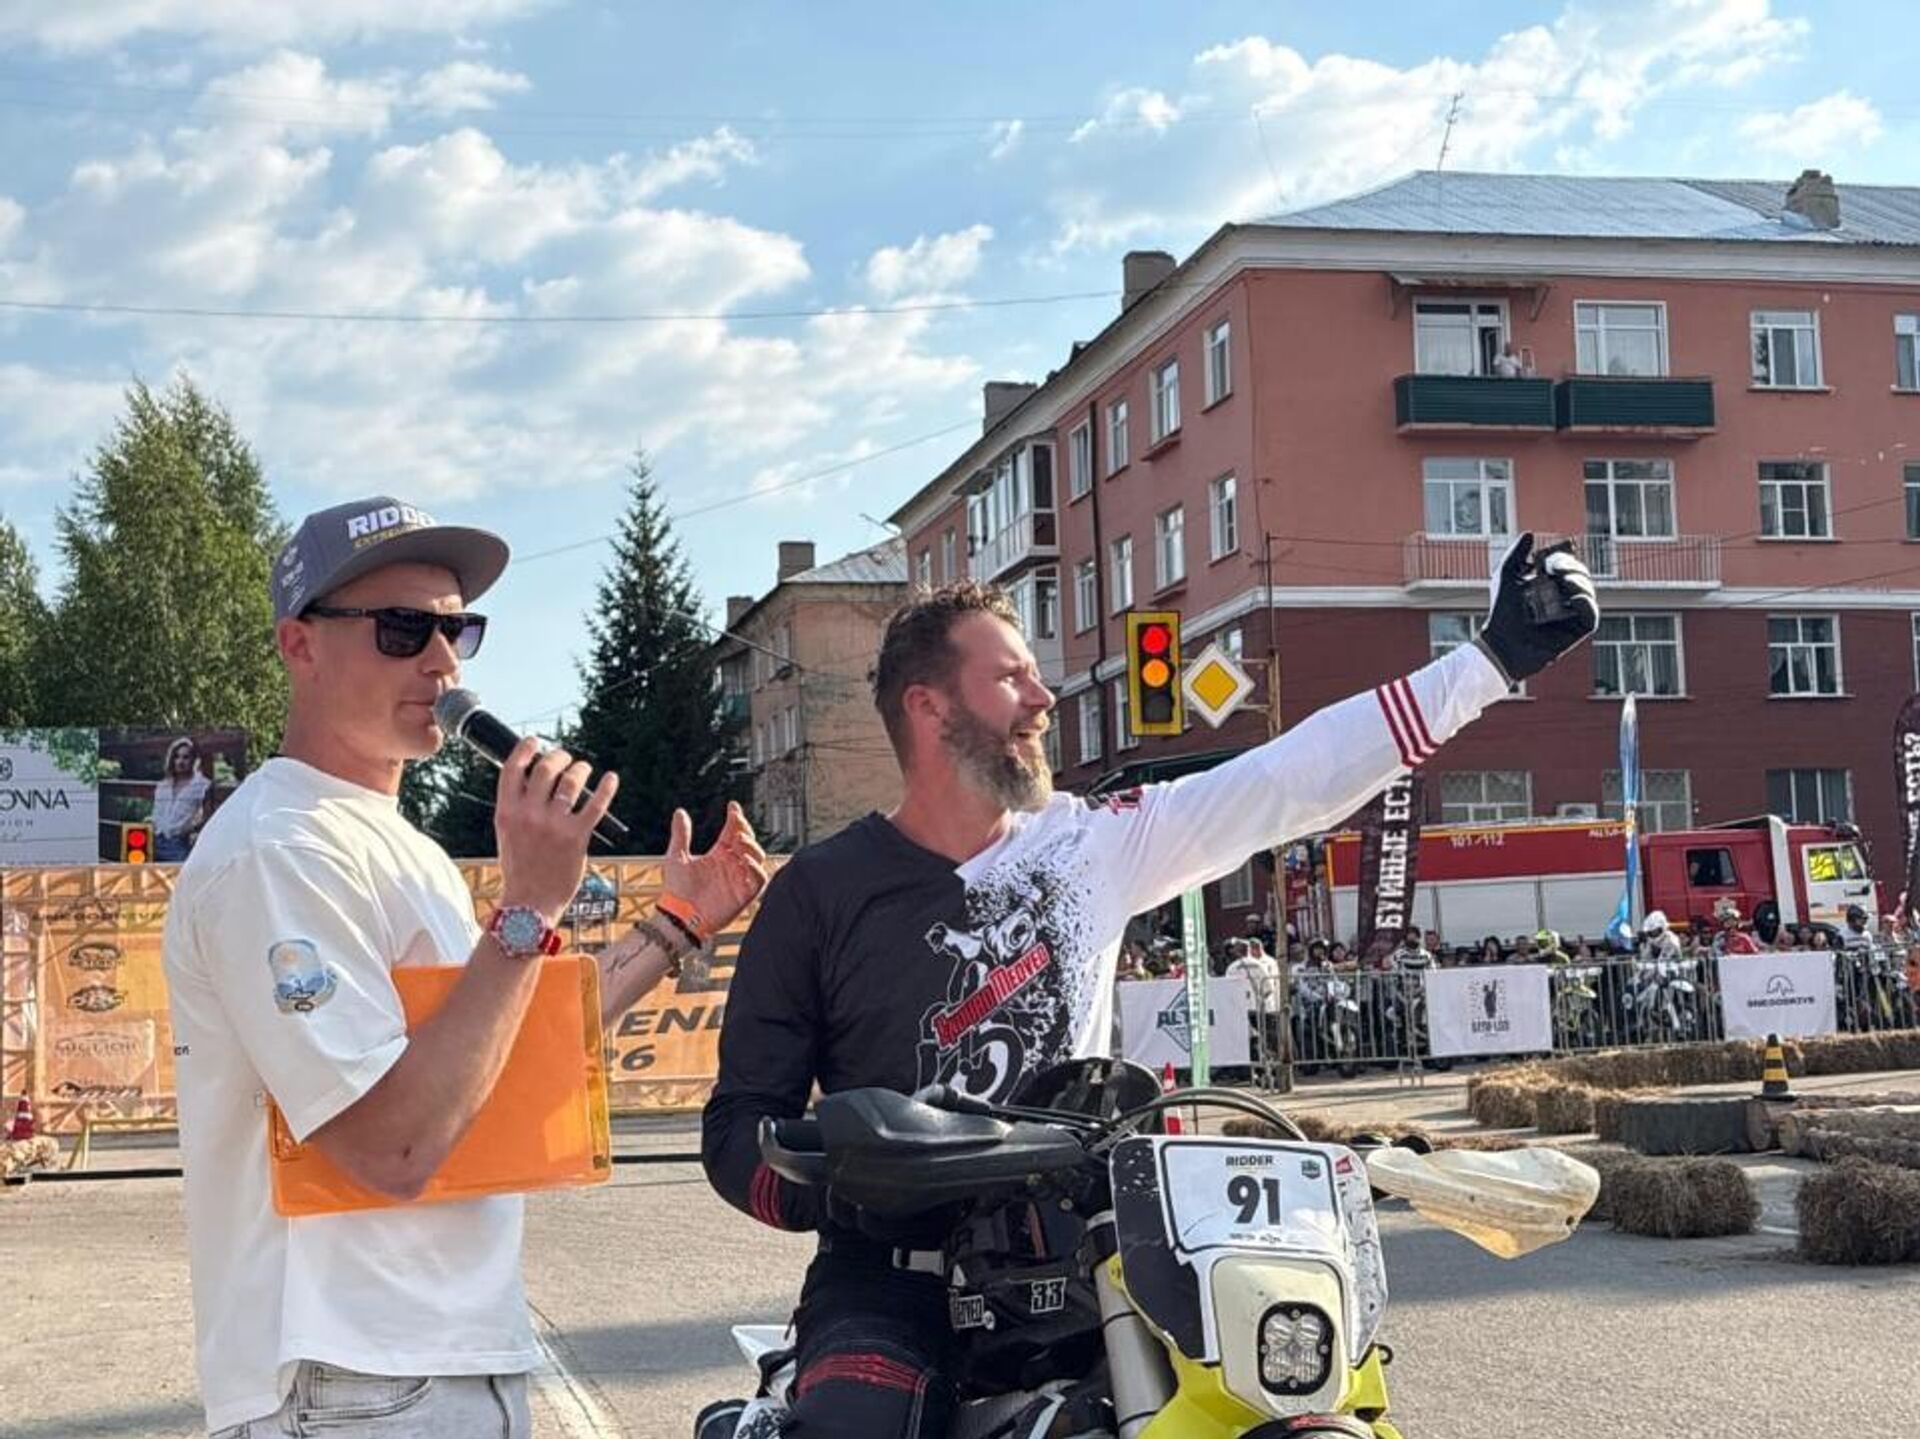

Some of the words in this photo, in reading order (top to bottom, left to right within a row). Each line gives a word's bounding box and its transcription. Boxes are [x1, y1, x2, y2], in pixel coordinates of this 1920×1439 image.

[1374, 829, 1409, 931] БУЙНЫЕ
[1225, 1155, 1273, 1167] RIDDER
[1227, 1175, 1281, 1226] 91
